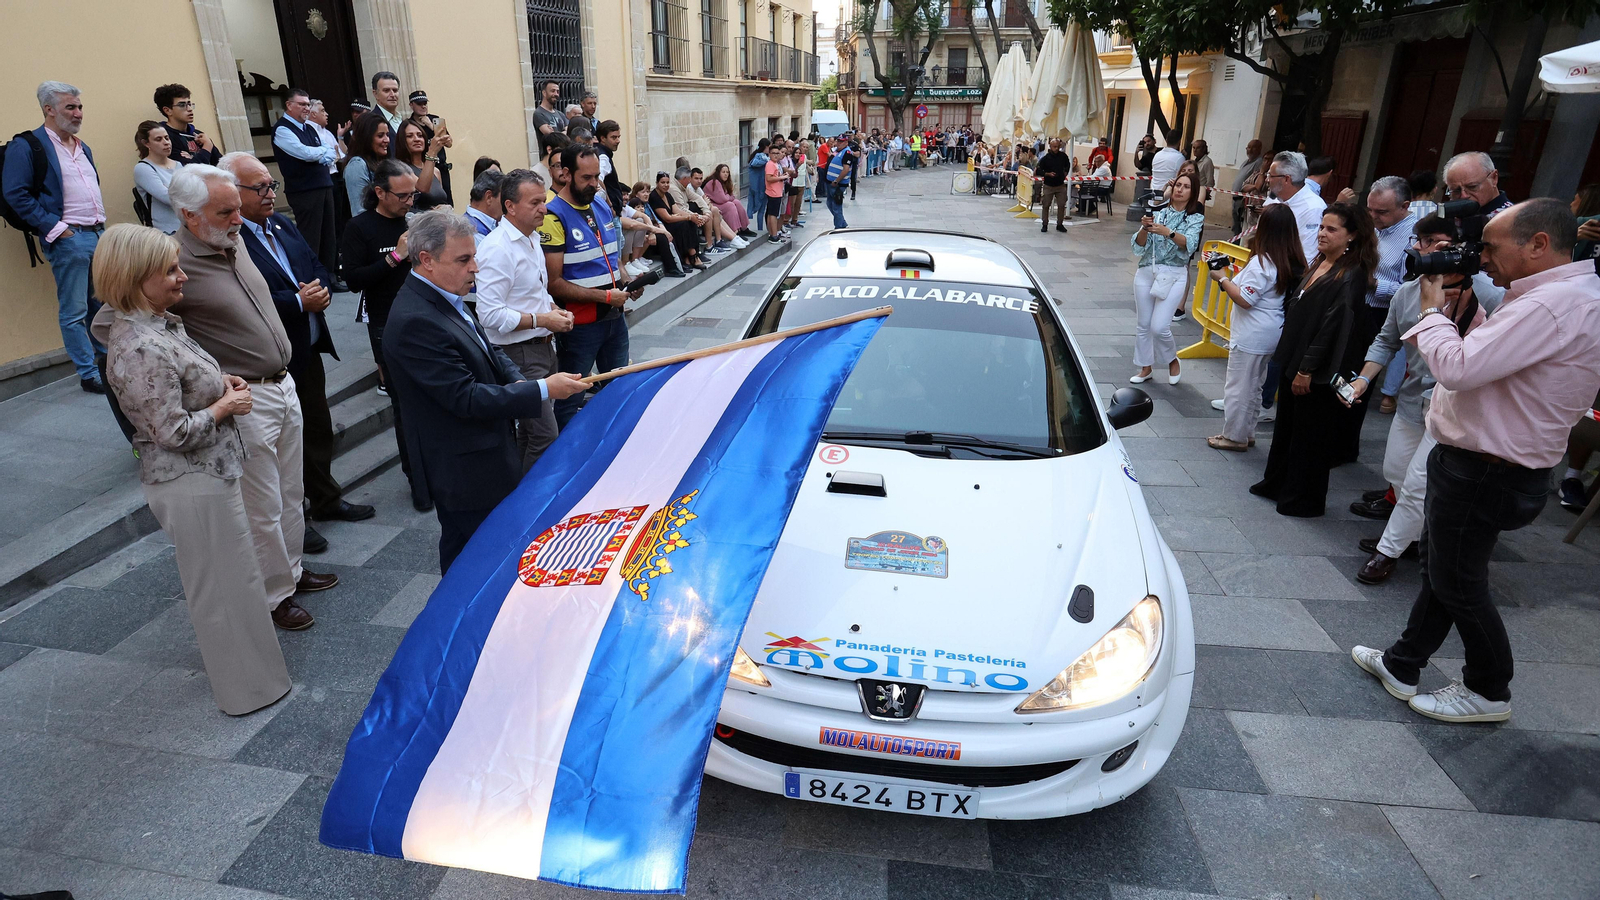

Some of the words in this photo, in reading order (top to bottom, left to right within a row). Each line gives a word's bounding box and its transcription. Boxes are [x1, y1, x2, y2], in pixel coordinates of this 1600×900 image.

[803, 285, 880, 299] PACO
[882, 286, 1040, 314] ALABARCE
[827, 449, 841, 460] E
[891, 534, 906, 544] 27
[835, 639, 927, 657] Panadería
[934, 649, 1027, 669] Pastelería
[822, 728, 960, 760] MOLAUTOSPORT
[809, 779, 893, 807] 8424
[906, 790, 972, 815] BTX
